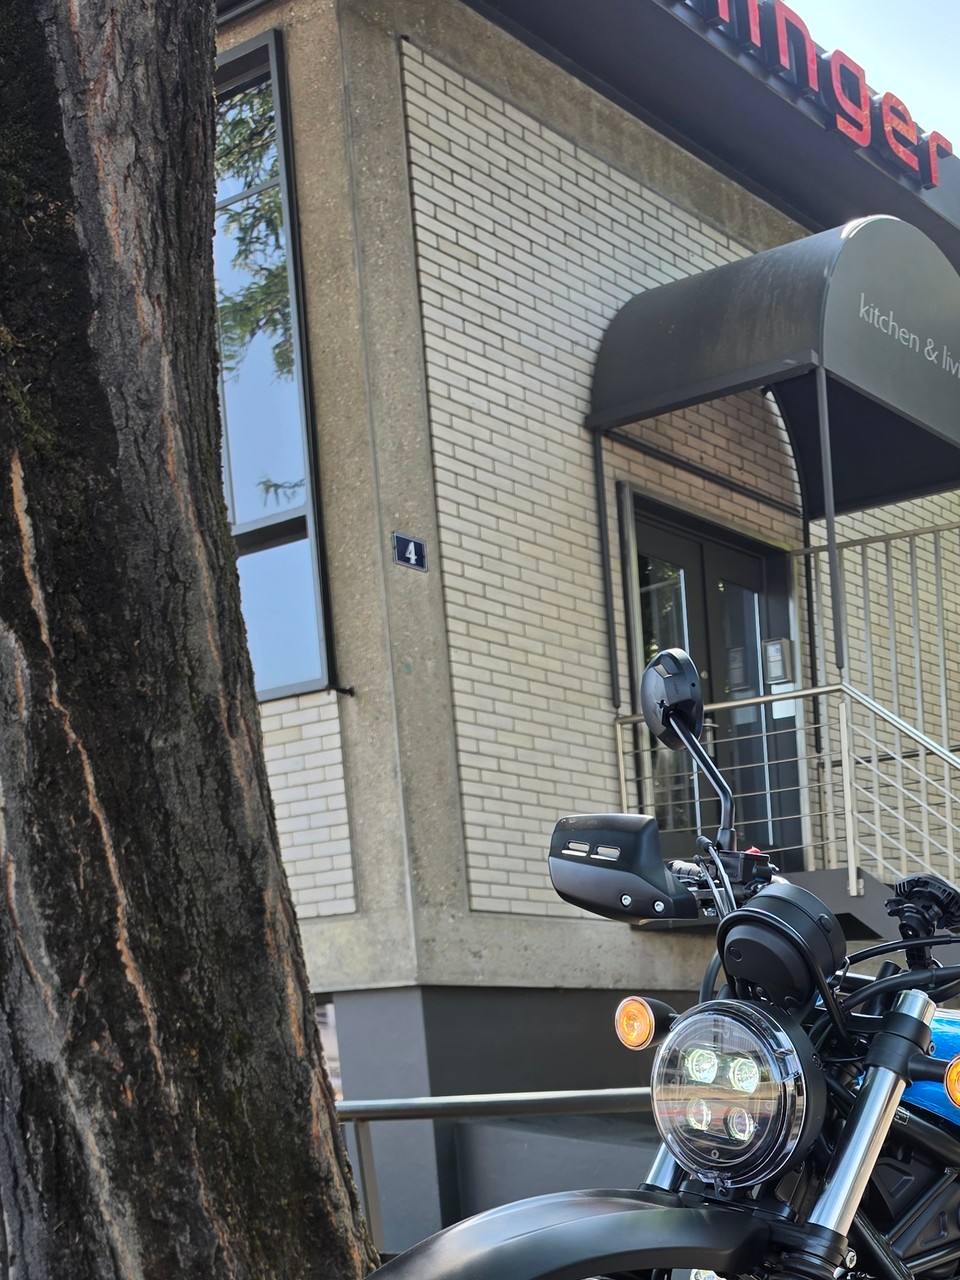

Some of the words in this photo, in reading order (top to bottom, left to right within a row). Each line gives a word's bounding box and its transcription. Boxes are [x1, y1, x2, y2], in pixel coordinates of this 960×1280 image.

[718, 0, 954, 188] inger
[859, 292, 920, 353] kitchen
[924, 338, 939, 364] &
[405, 541, 418, 565] 4
